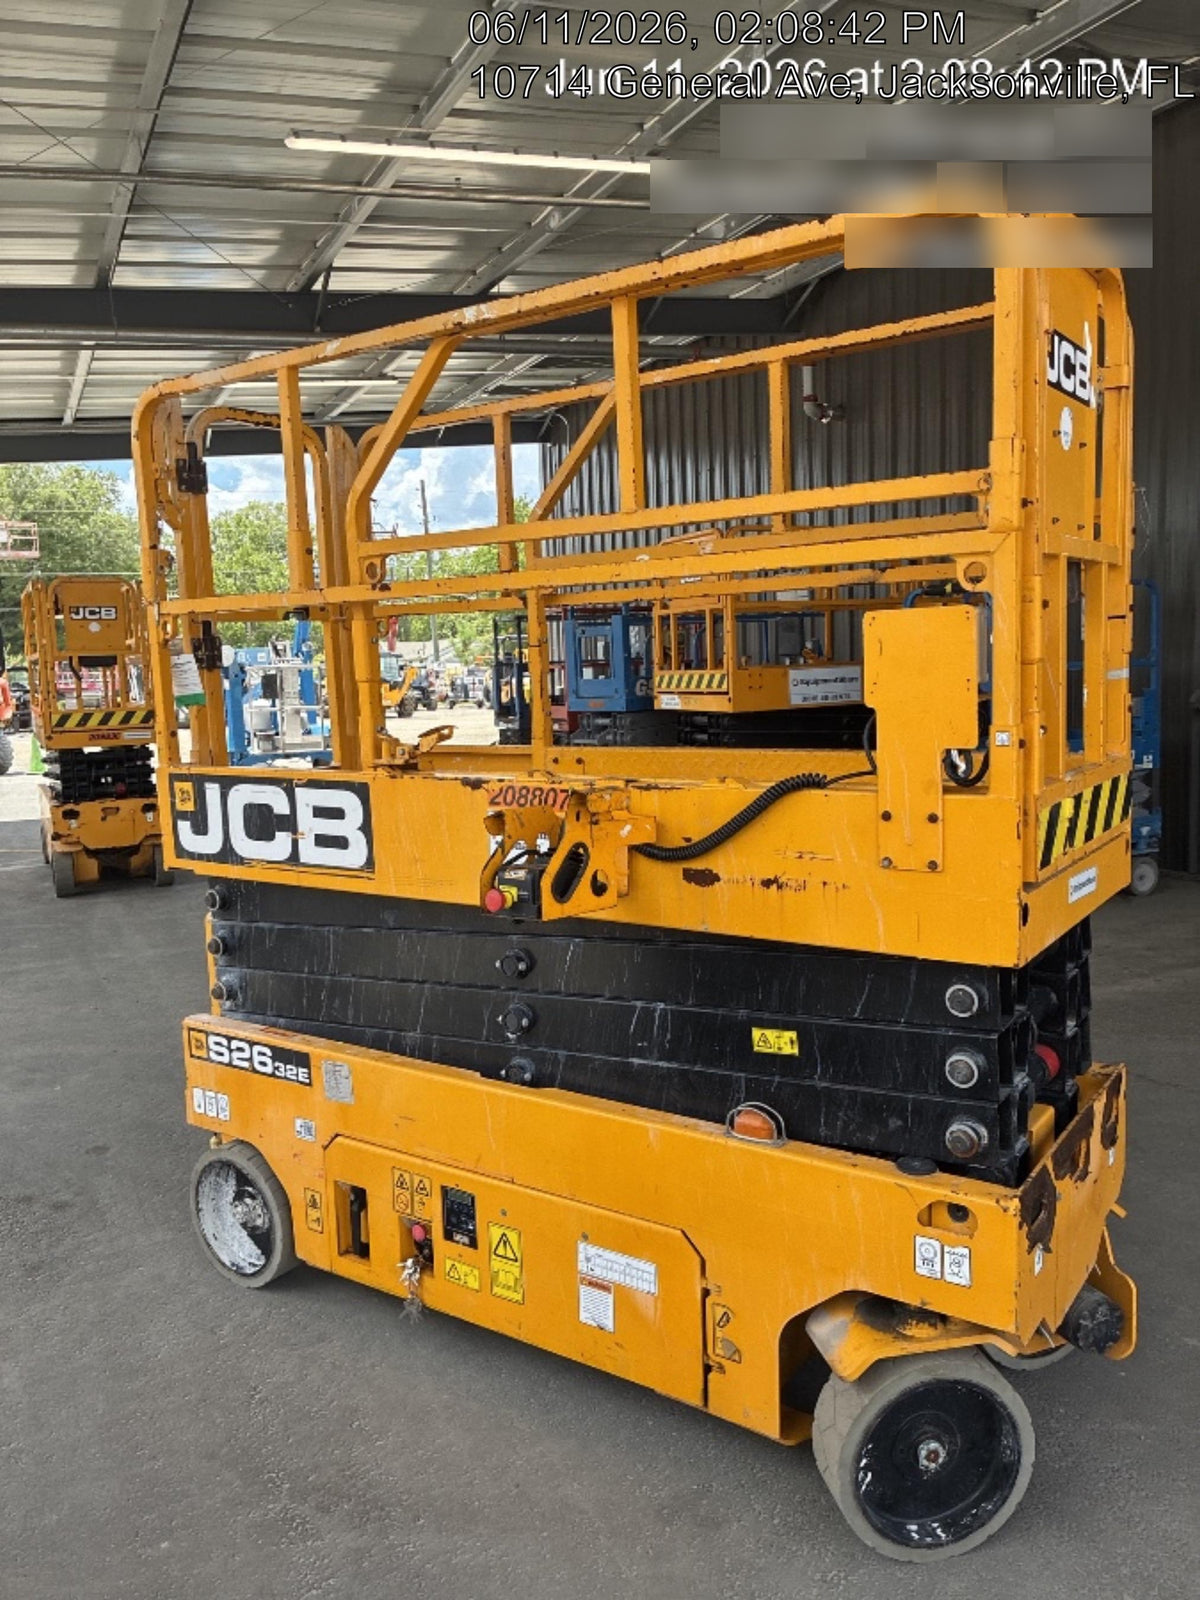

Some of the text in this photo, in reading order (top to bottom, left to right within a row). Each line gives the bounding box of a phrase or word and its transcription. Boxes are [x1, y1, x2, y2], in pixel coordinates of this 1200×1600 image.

[1047, 334, 1091, 401] JCB
[71, 607, 116, 619] JCB
[489, 785, 570, 811] 208807
[177, 782, 369, 869] JCB
